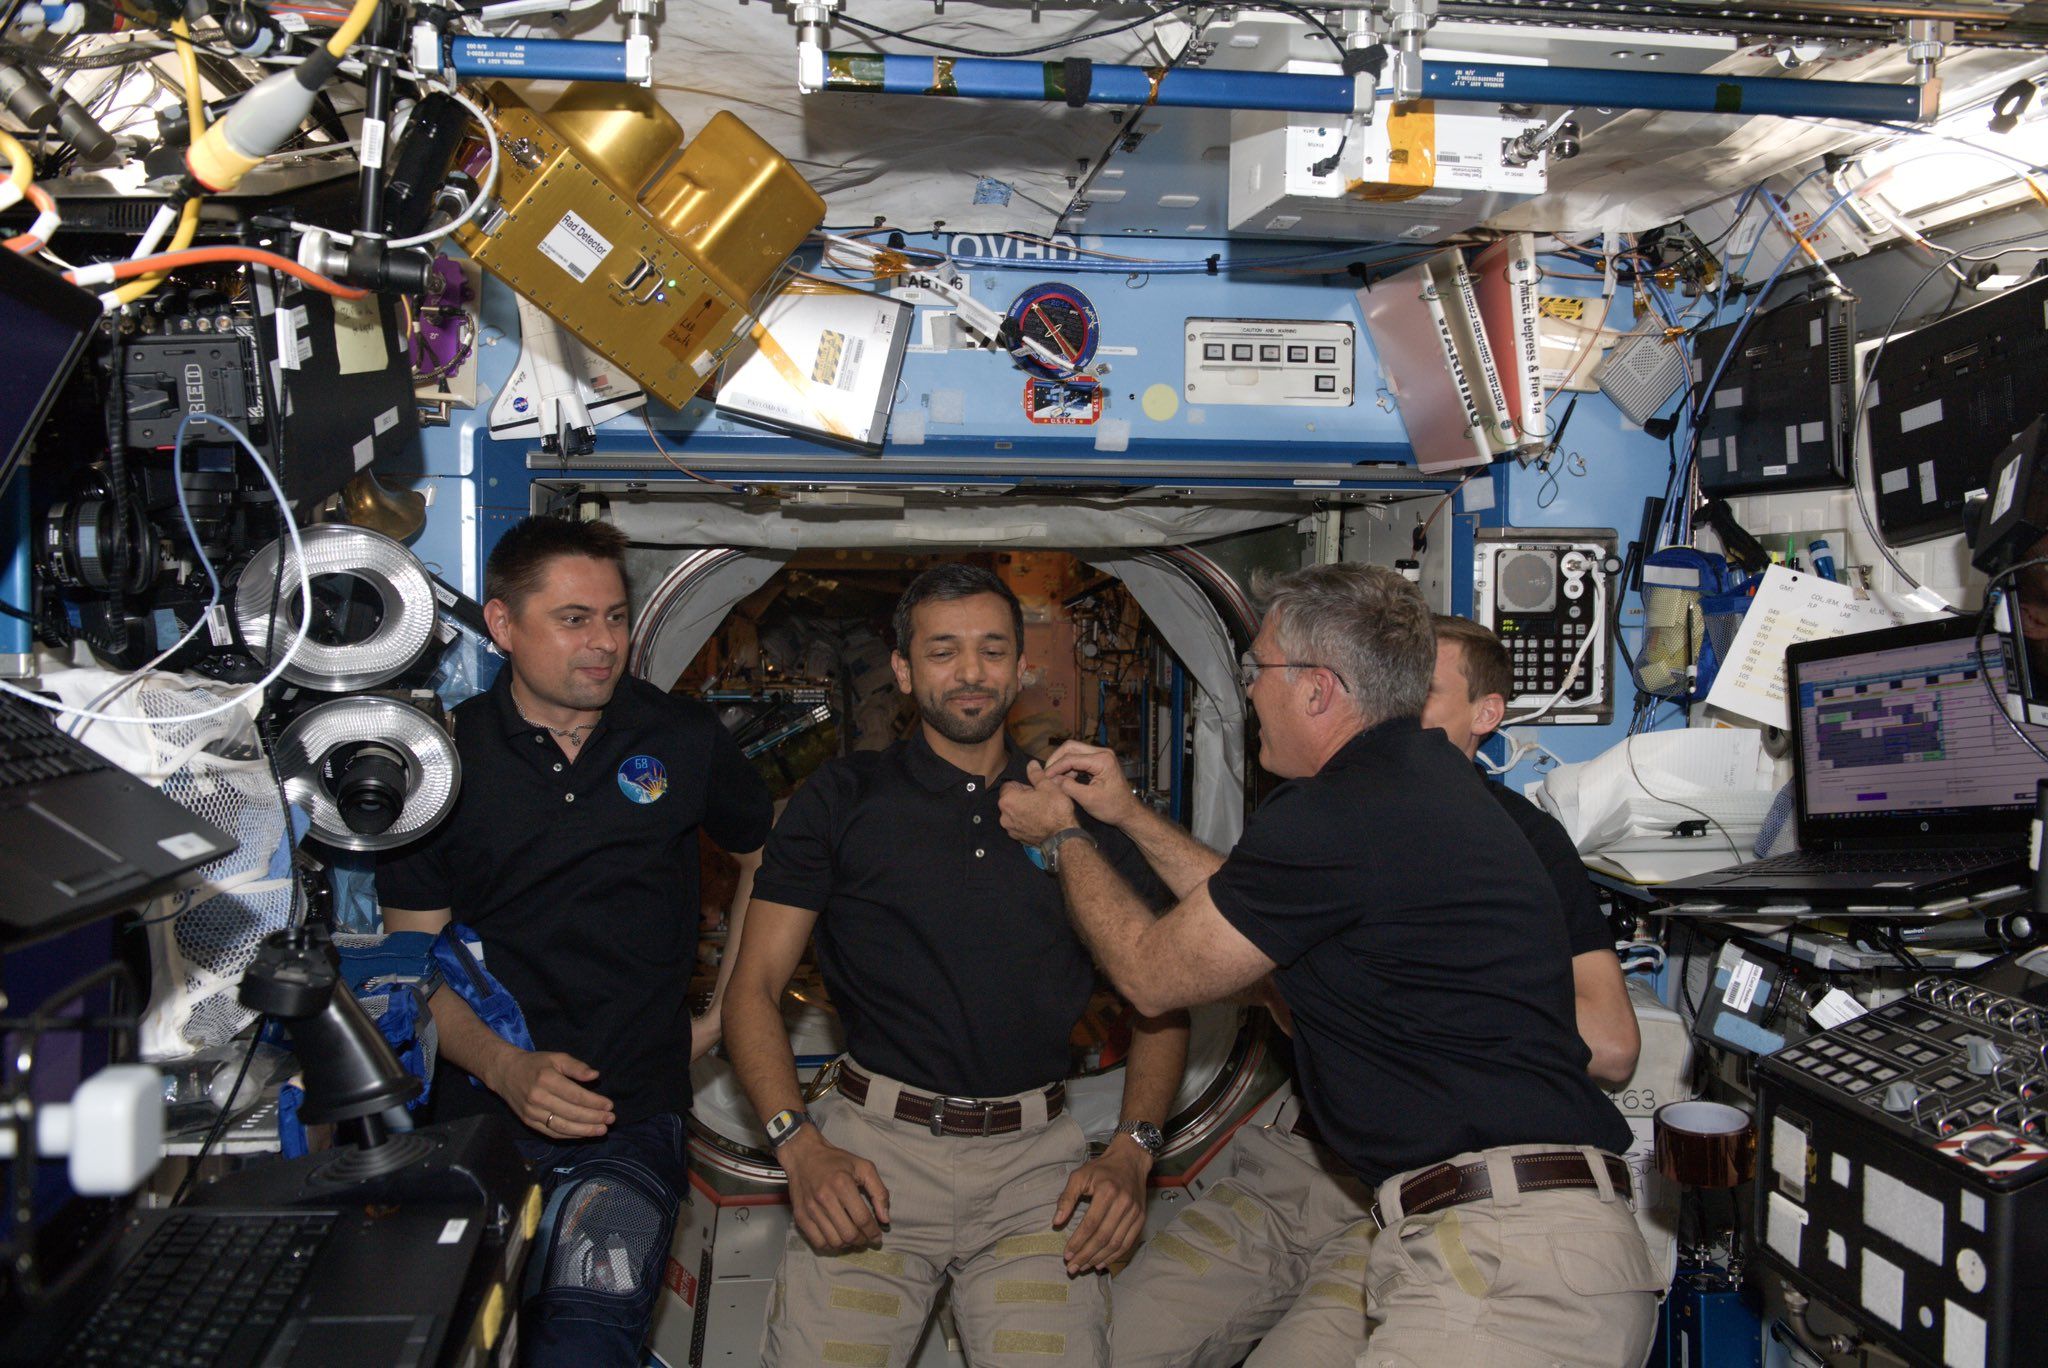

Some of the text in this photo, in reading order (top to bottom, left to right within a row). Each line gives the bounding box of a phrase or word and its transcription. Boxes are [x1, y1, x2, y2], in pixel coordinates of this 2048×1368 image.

[561, 214, 579, 232] Rad
[576, 227, 607, 255] Detector
[1473, 319, 1492, 365] ONBOARD
[1521, 317, 1536, 362] Depress
[1528, 365, 1539, 373] &
[1485, 365, 1507, 412] PORTABLE
[1529, 375, 1540, 398] Fire
[1800, 617, 1819, 628] Nicole
[1756, 631, 1769, 640] 070
[1796, 626, 1814, 636] Koichi
[1738, 672, 1750, 681] 105
[1733, 680, 1746, 688] 112
[635, 758, 648, 769] 68
